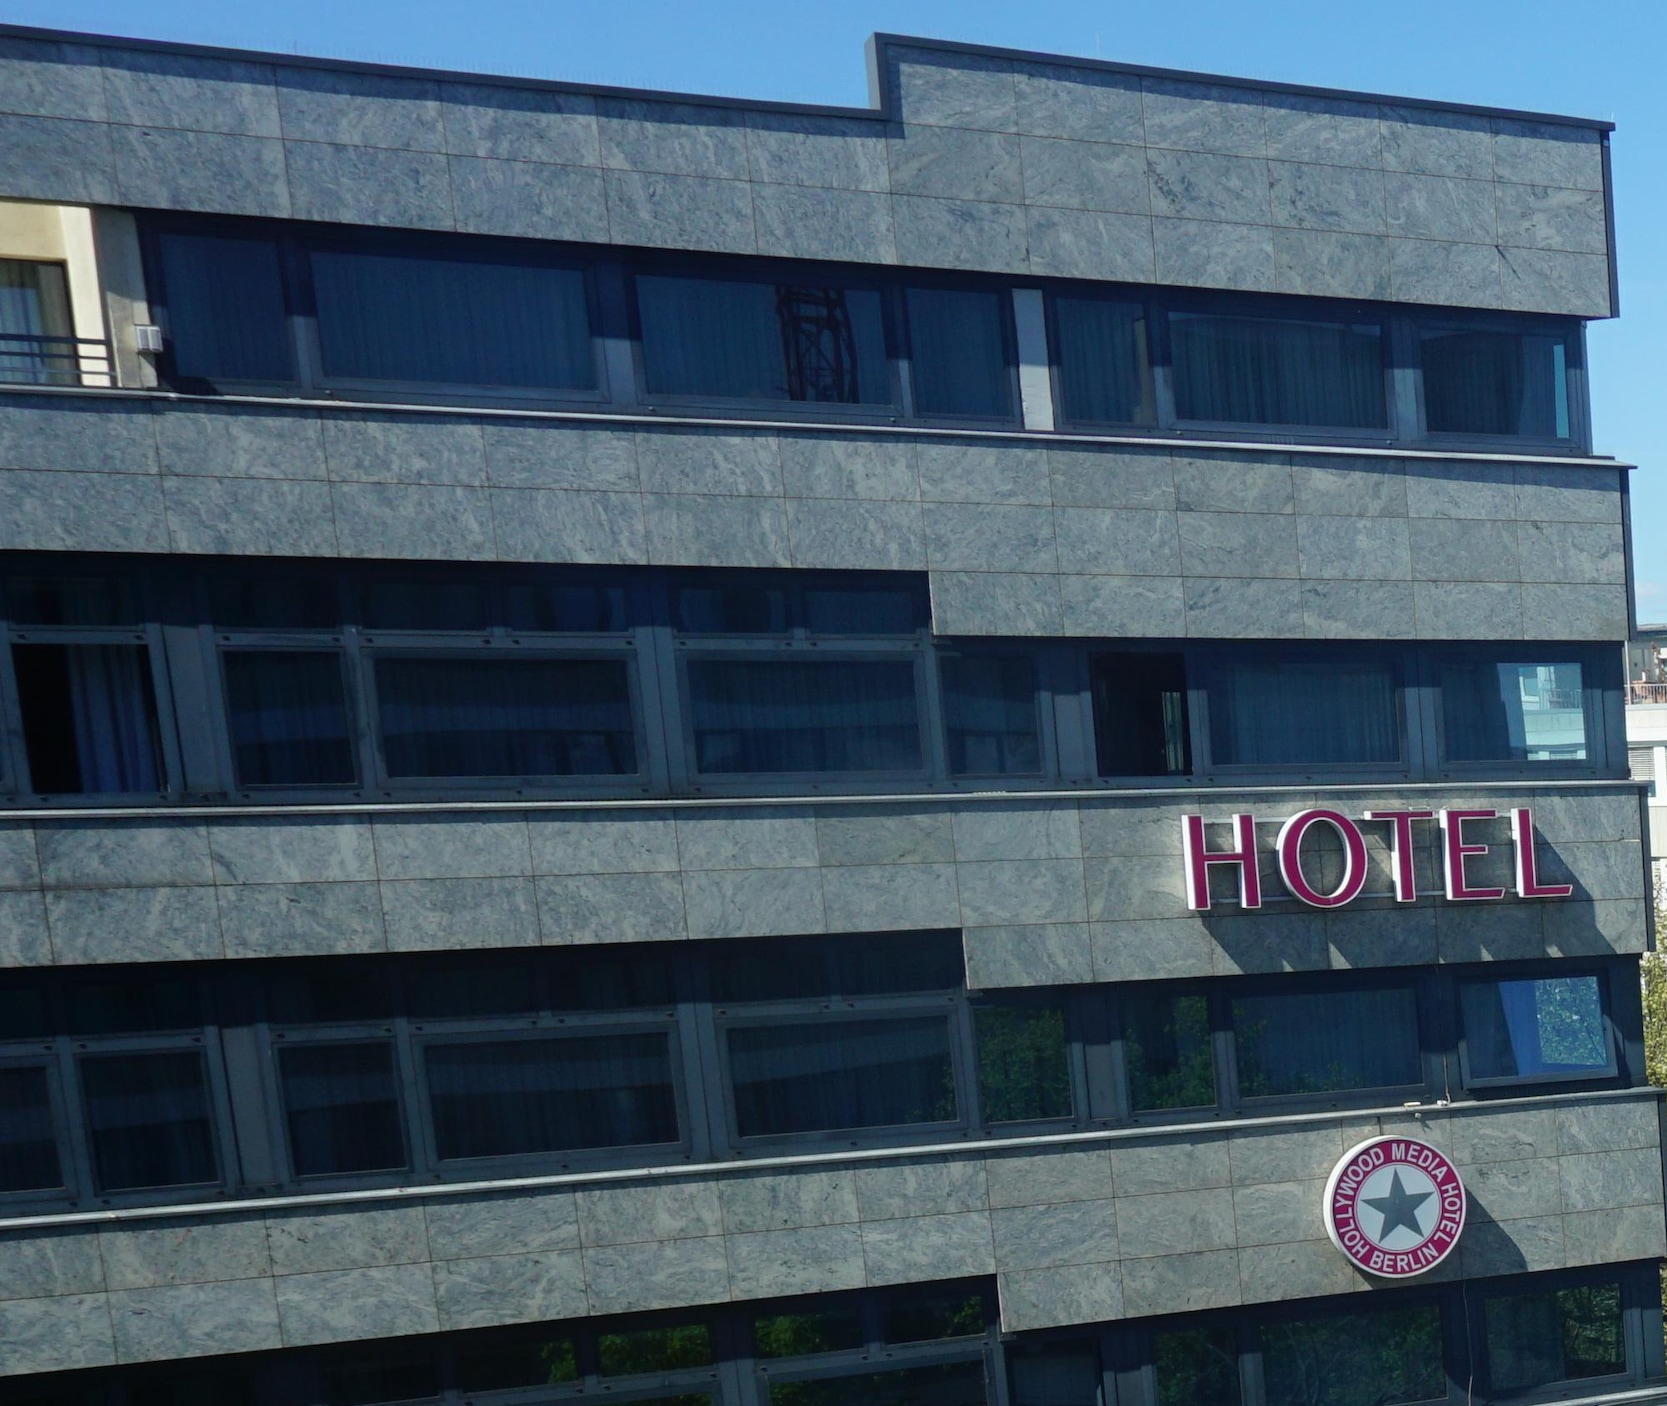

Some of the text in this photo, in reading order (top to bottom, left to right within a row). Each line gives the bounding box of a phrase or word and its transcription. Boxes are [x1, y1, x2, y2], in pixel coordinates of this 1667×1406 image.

[1181, 808, 1573, 911] HOTEL
[1335, 1142, 1462, 1273] HOLLYWOOD MEDIA HOTEL BERLIN
